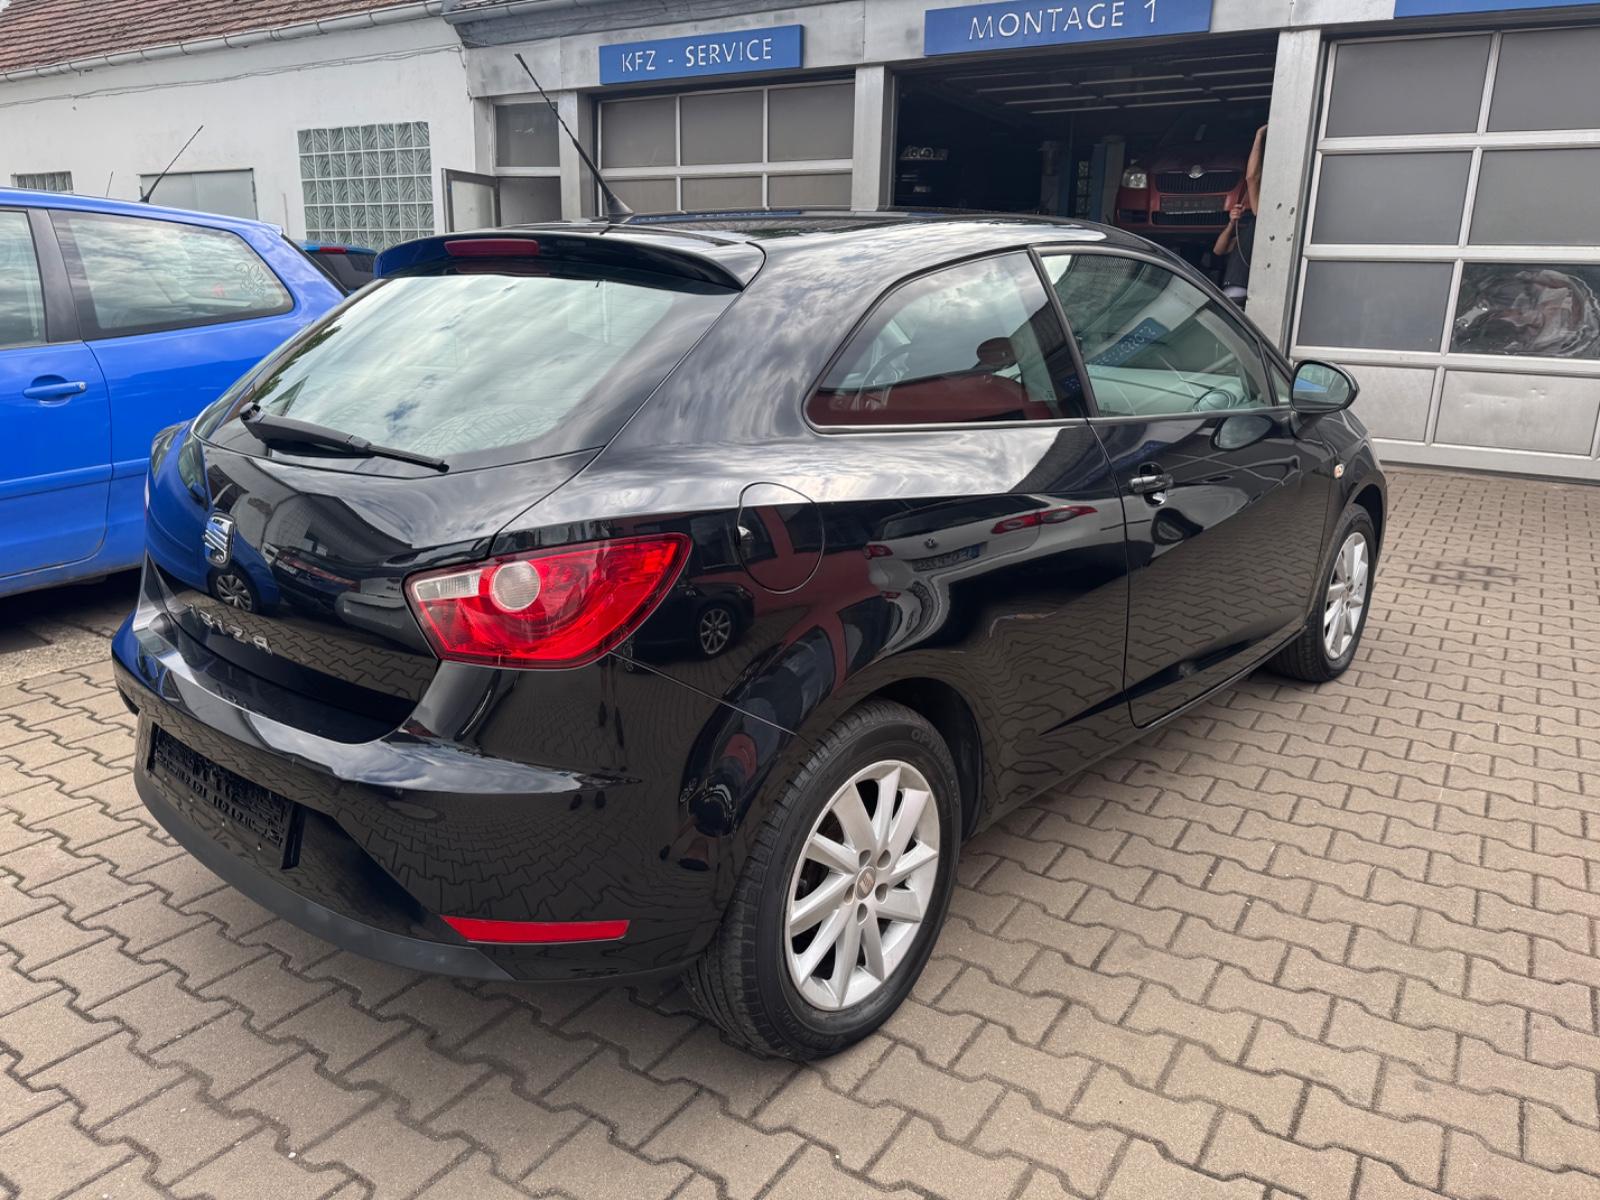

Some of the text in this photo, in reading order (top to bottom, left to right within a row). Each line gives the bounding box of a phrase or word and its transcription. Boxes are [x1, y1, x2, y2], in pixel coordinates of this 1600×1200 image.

[969, 1, 1157, 40] MONTAGE 1
[622, 50, 657, 72] KFZ
[685, 38, 773, 67] SERVICE
